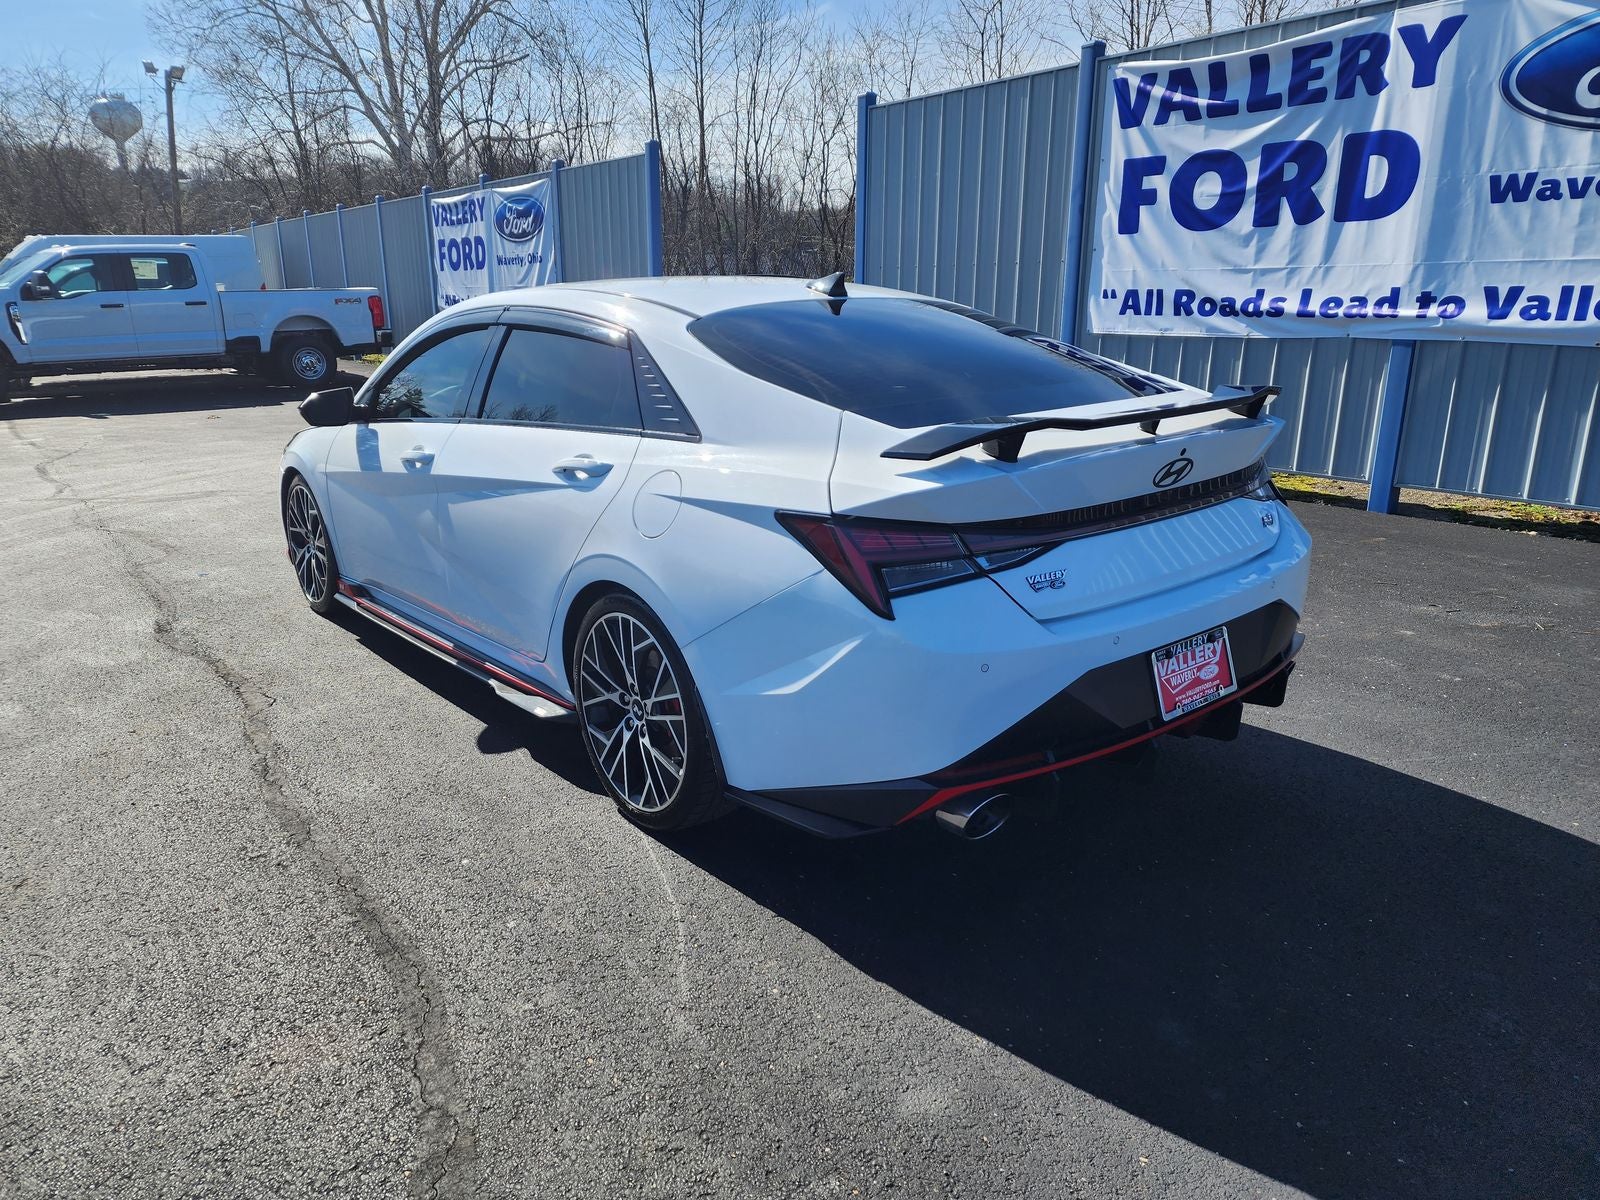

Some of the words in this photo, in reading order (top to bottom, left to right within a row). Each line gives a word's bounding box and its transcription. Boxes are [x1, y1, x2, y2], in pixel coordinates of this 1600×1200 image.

[1112, 14, 1470, 130] VALLERY
[1116, 129, 1421, 236] FORD
[1488, 171, 1600, 205] Wav
[431, 196, 486, 228] VALLERY
[503, 204, 536, 235] Ford
[438, 235, 487, 272] FORD
[527, 251, 543, 265] Ohio
[1173, 287, 1288, 318] Roads
[1295, 285, 1401, 319] Lead
[1415, 290, 1467, 320] to
[1483, 284, 1600, 322] Vall
[1026, 569, 1068, 584] VALLERY
[1157, 639, 1223, 677] VALLERY
[1170, 633, 1209, 656] VALLERY
